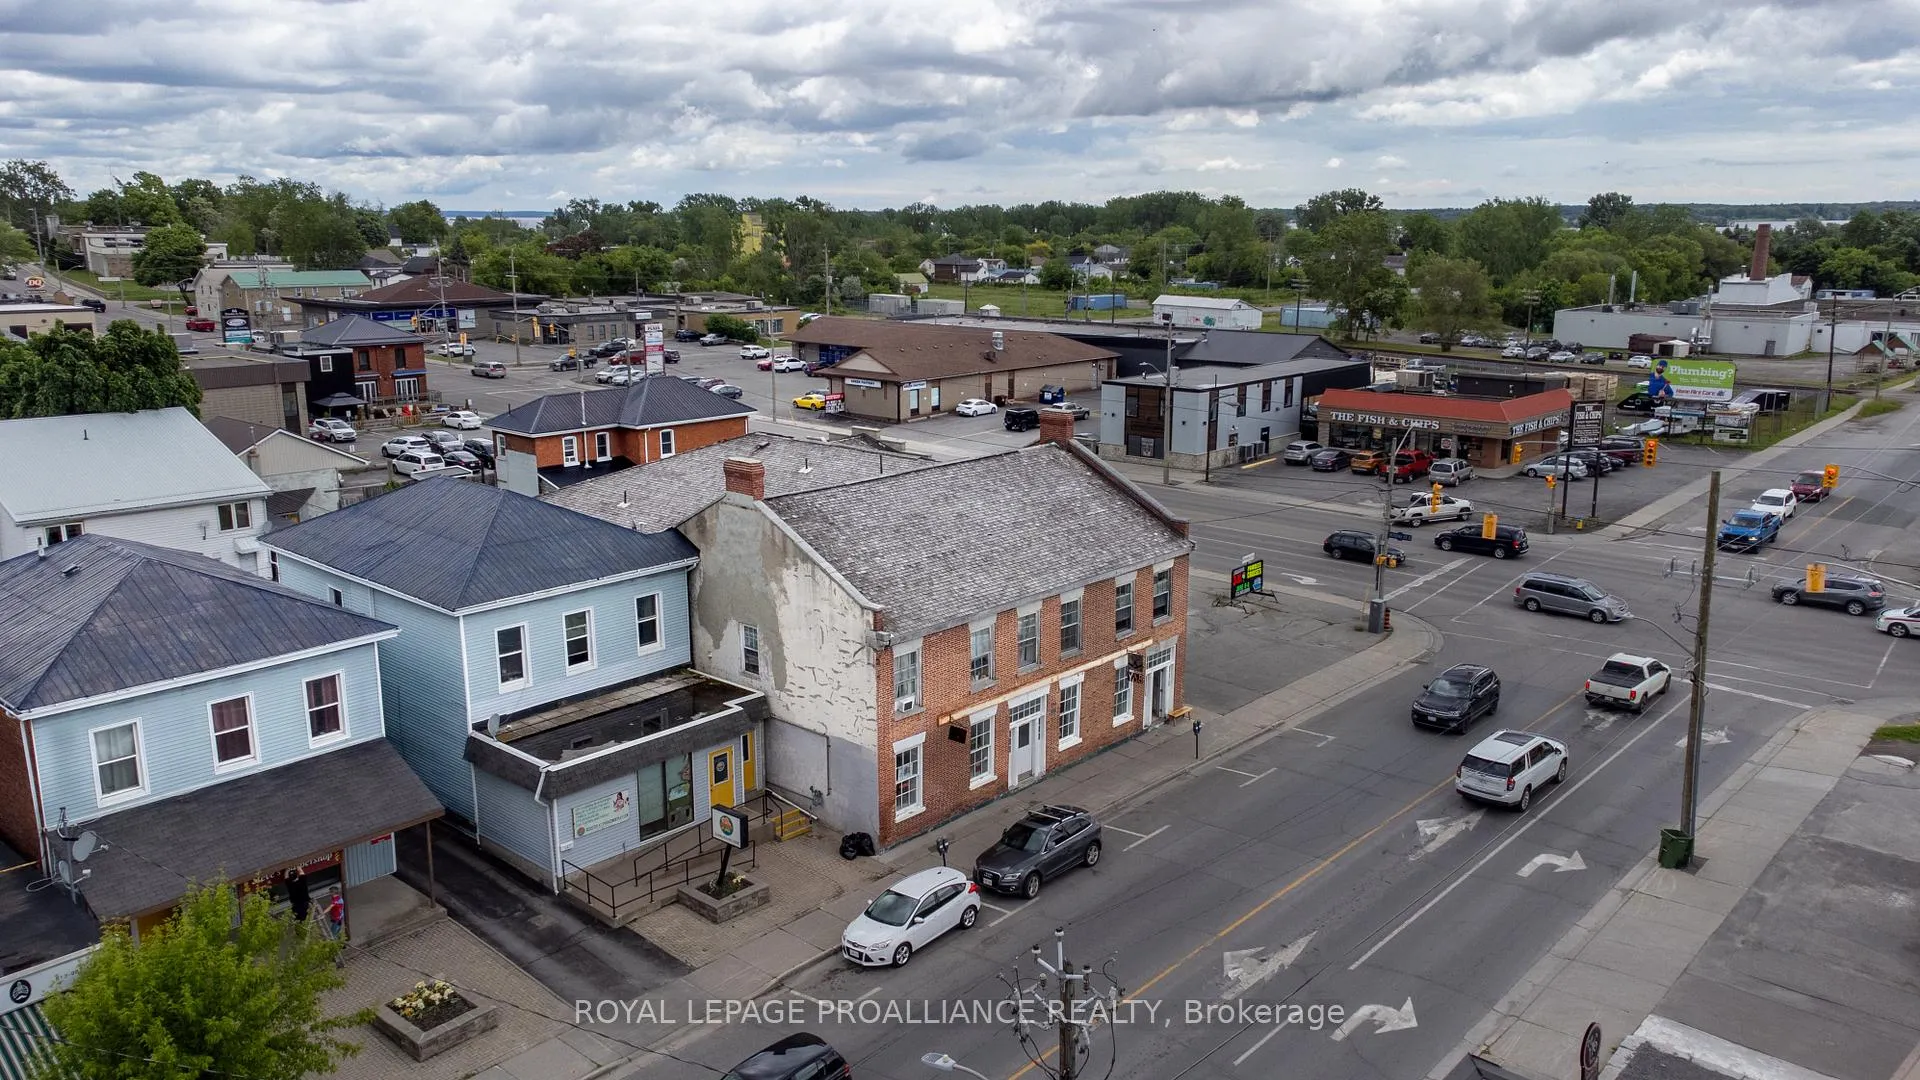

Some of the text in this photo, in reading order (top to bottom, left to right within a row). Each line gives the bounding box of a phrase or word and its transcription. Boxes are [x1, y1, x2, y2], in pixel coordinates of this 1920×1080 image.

[1669, 365, 1734, 380] Plumbing?
[1330, 411, 1354, 422] THE
[1358, 414, 1386, 425] FISH
[1388, 417, 1399, 426] &
[1401, 418, 1440, 430] CHIPS
[1512, 423, 1525, 436] THE
[1524, 419, 1538, 432] FISH
[1543, 414, 1561, 428] CHIPS
